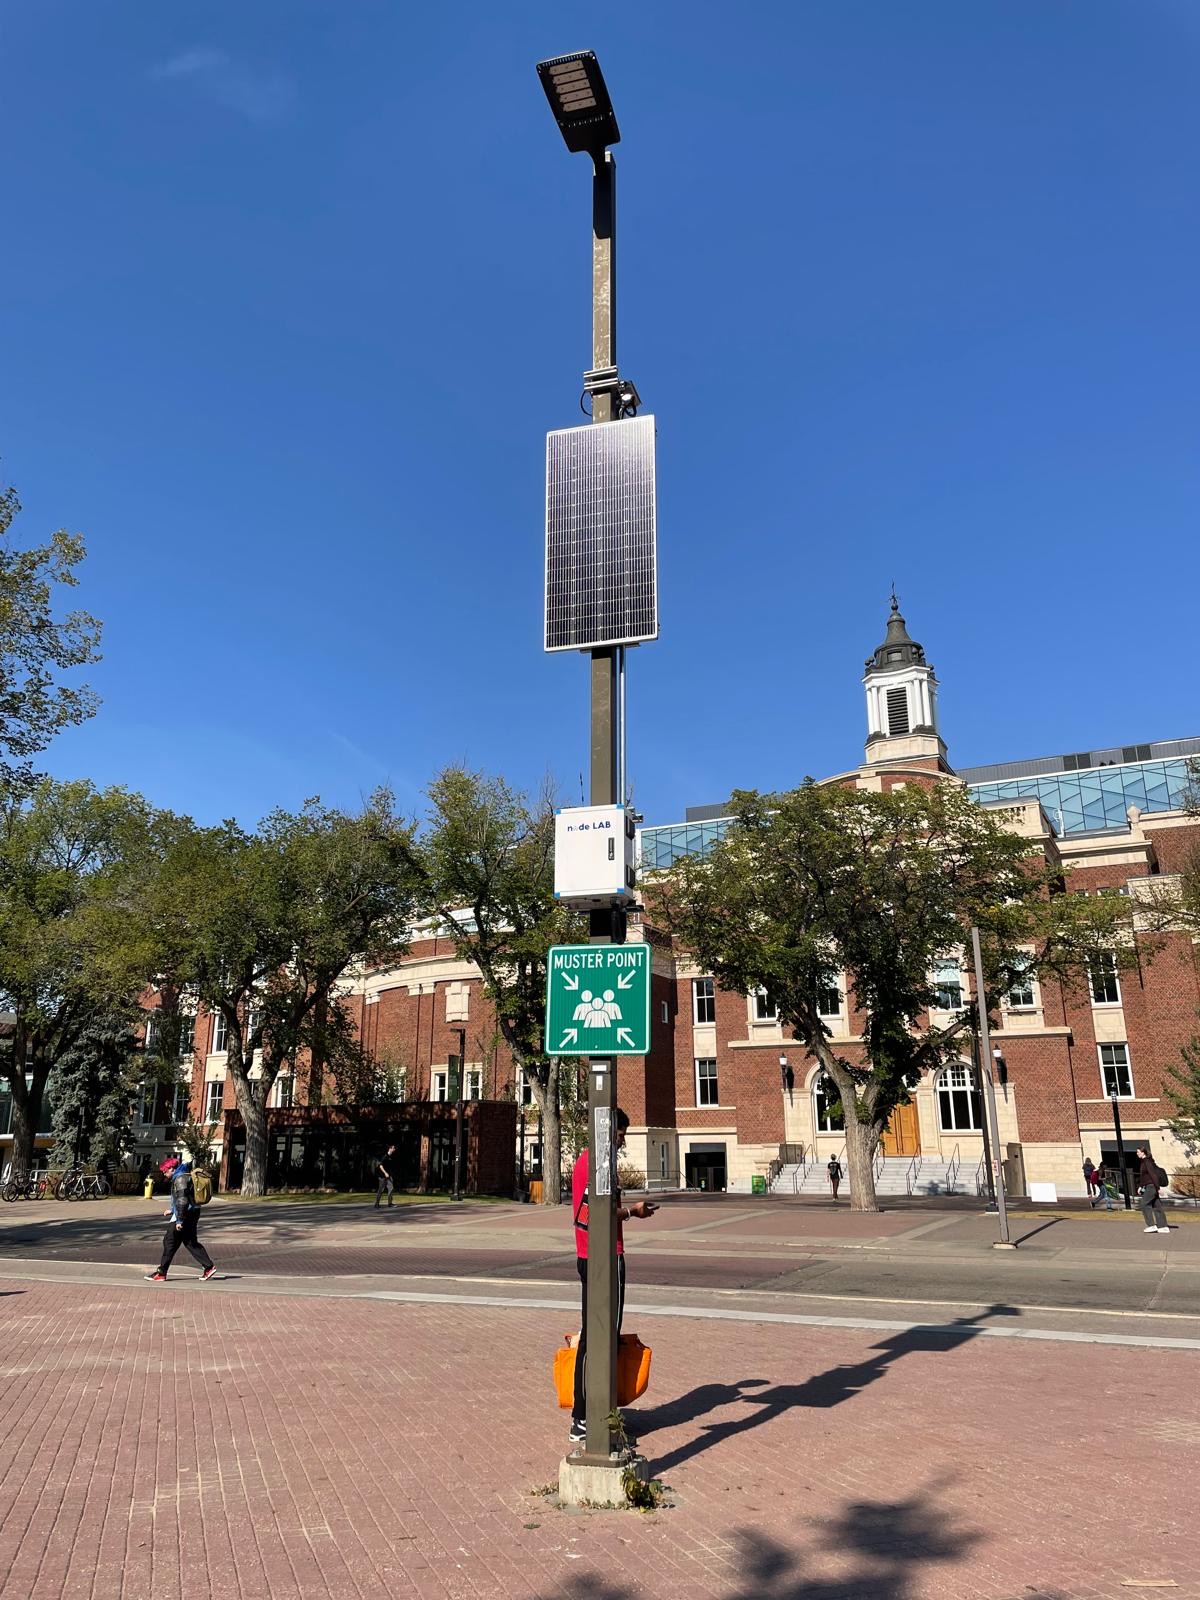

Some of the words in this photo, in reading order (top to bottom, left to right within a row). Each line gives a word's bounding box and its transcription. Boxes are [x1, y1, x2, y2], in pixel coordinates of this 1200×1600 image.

[592, 821, 611, 830] LAB
[554, 953, 603, 969] MUSTER
[607, 952, 644, 968] POINT
